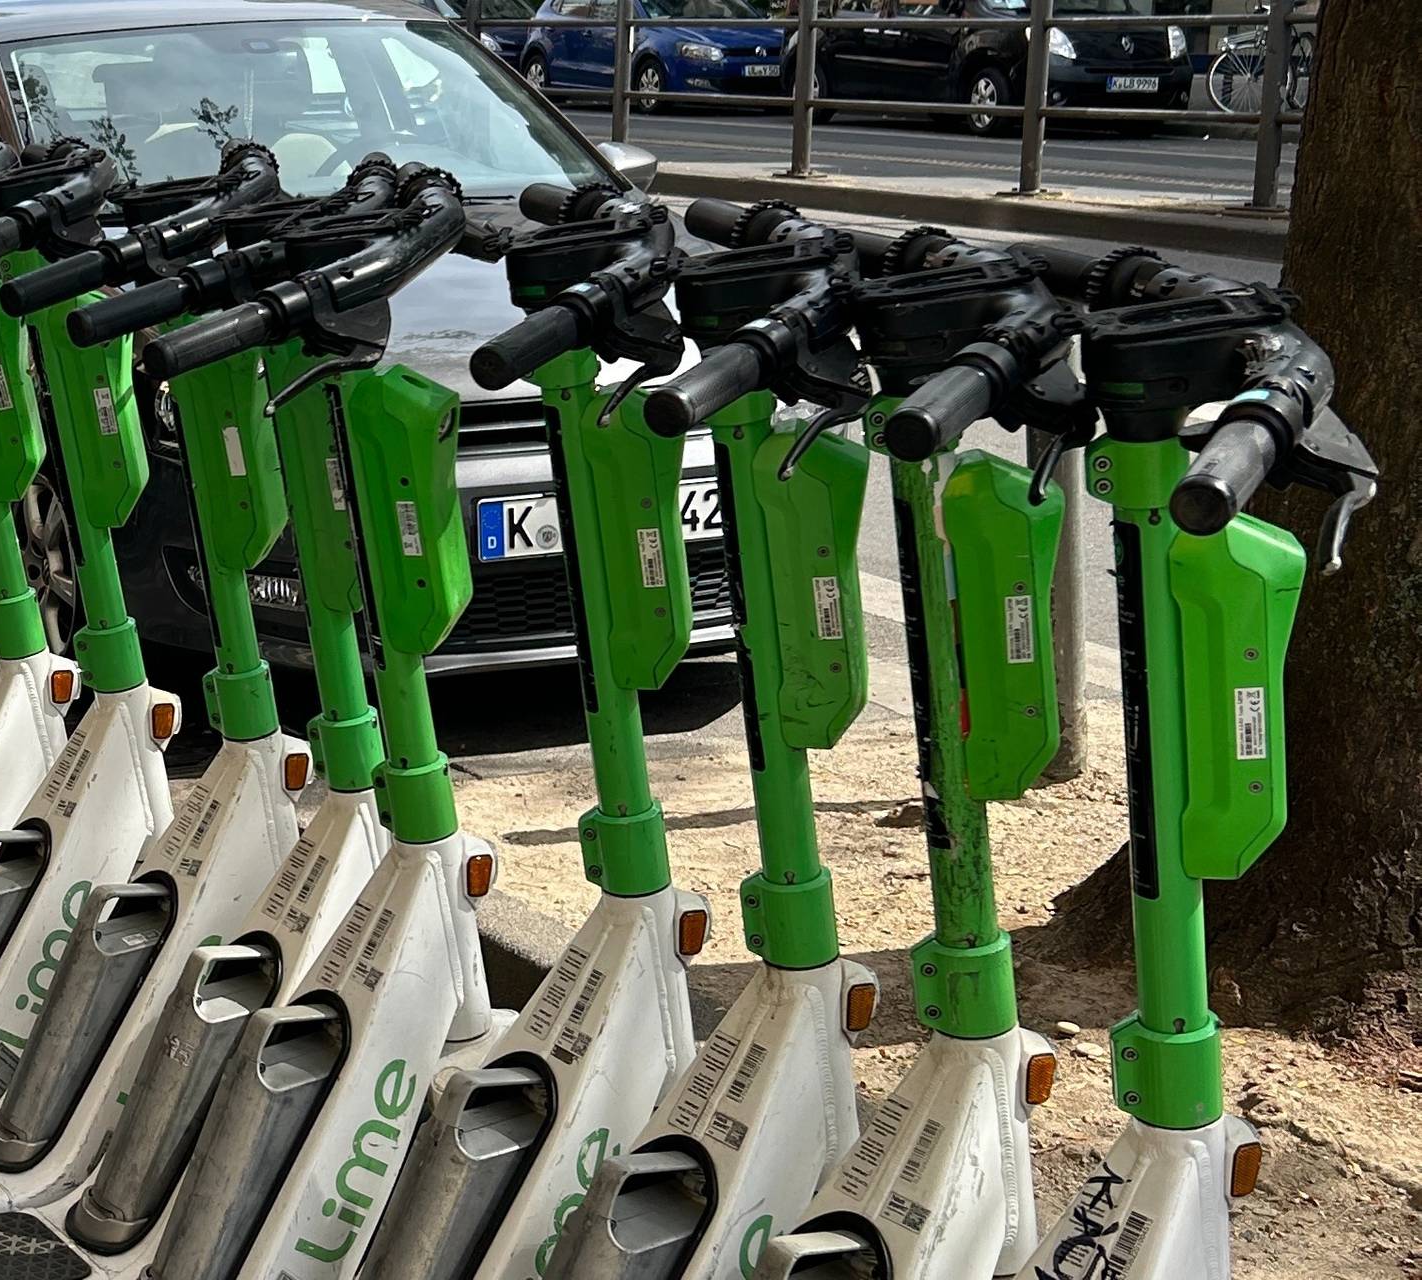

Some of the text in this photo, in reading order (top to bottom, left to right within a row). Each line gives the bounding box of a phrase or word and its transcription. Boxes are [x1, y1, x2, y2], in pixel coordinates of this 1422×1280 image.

[486, 535, 498, 550] D
[508, 488, 725, 550] K 42
[294, 1058, 417, 1263] Lime
